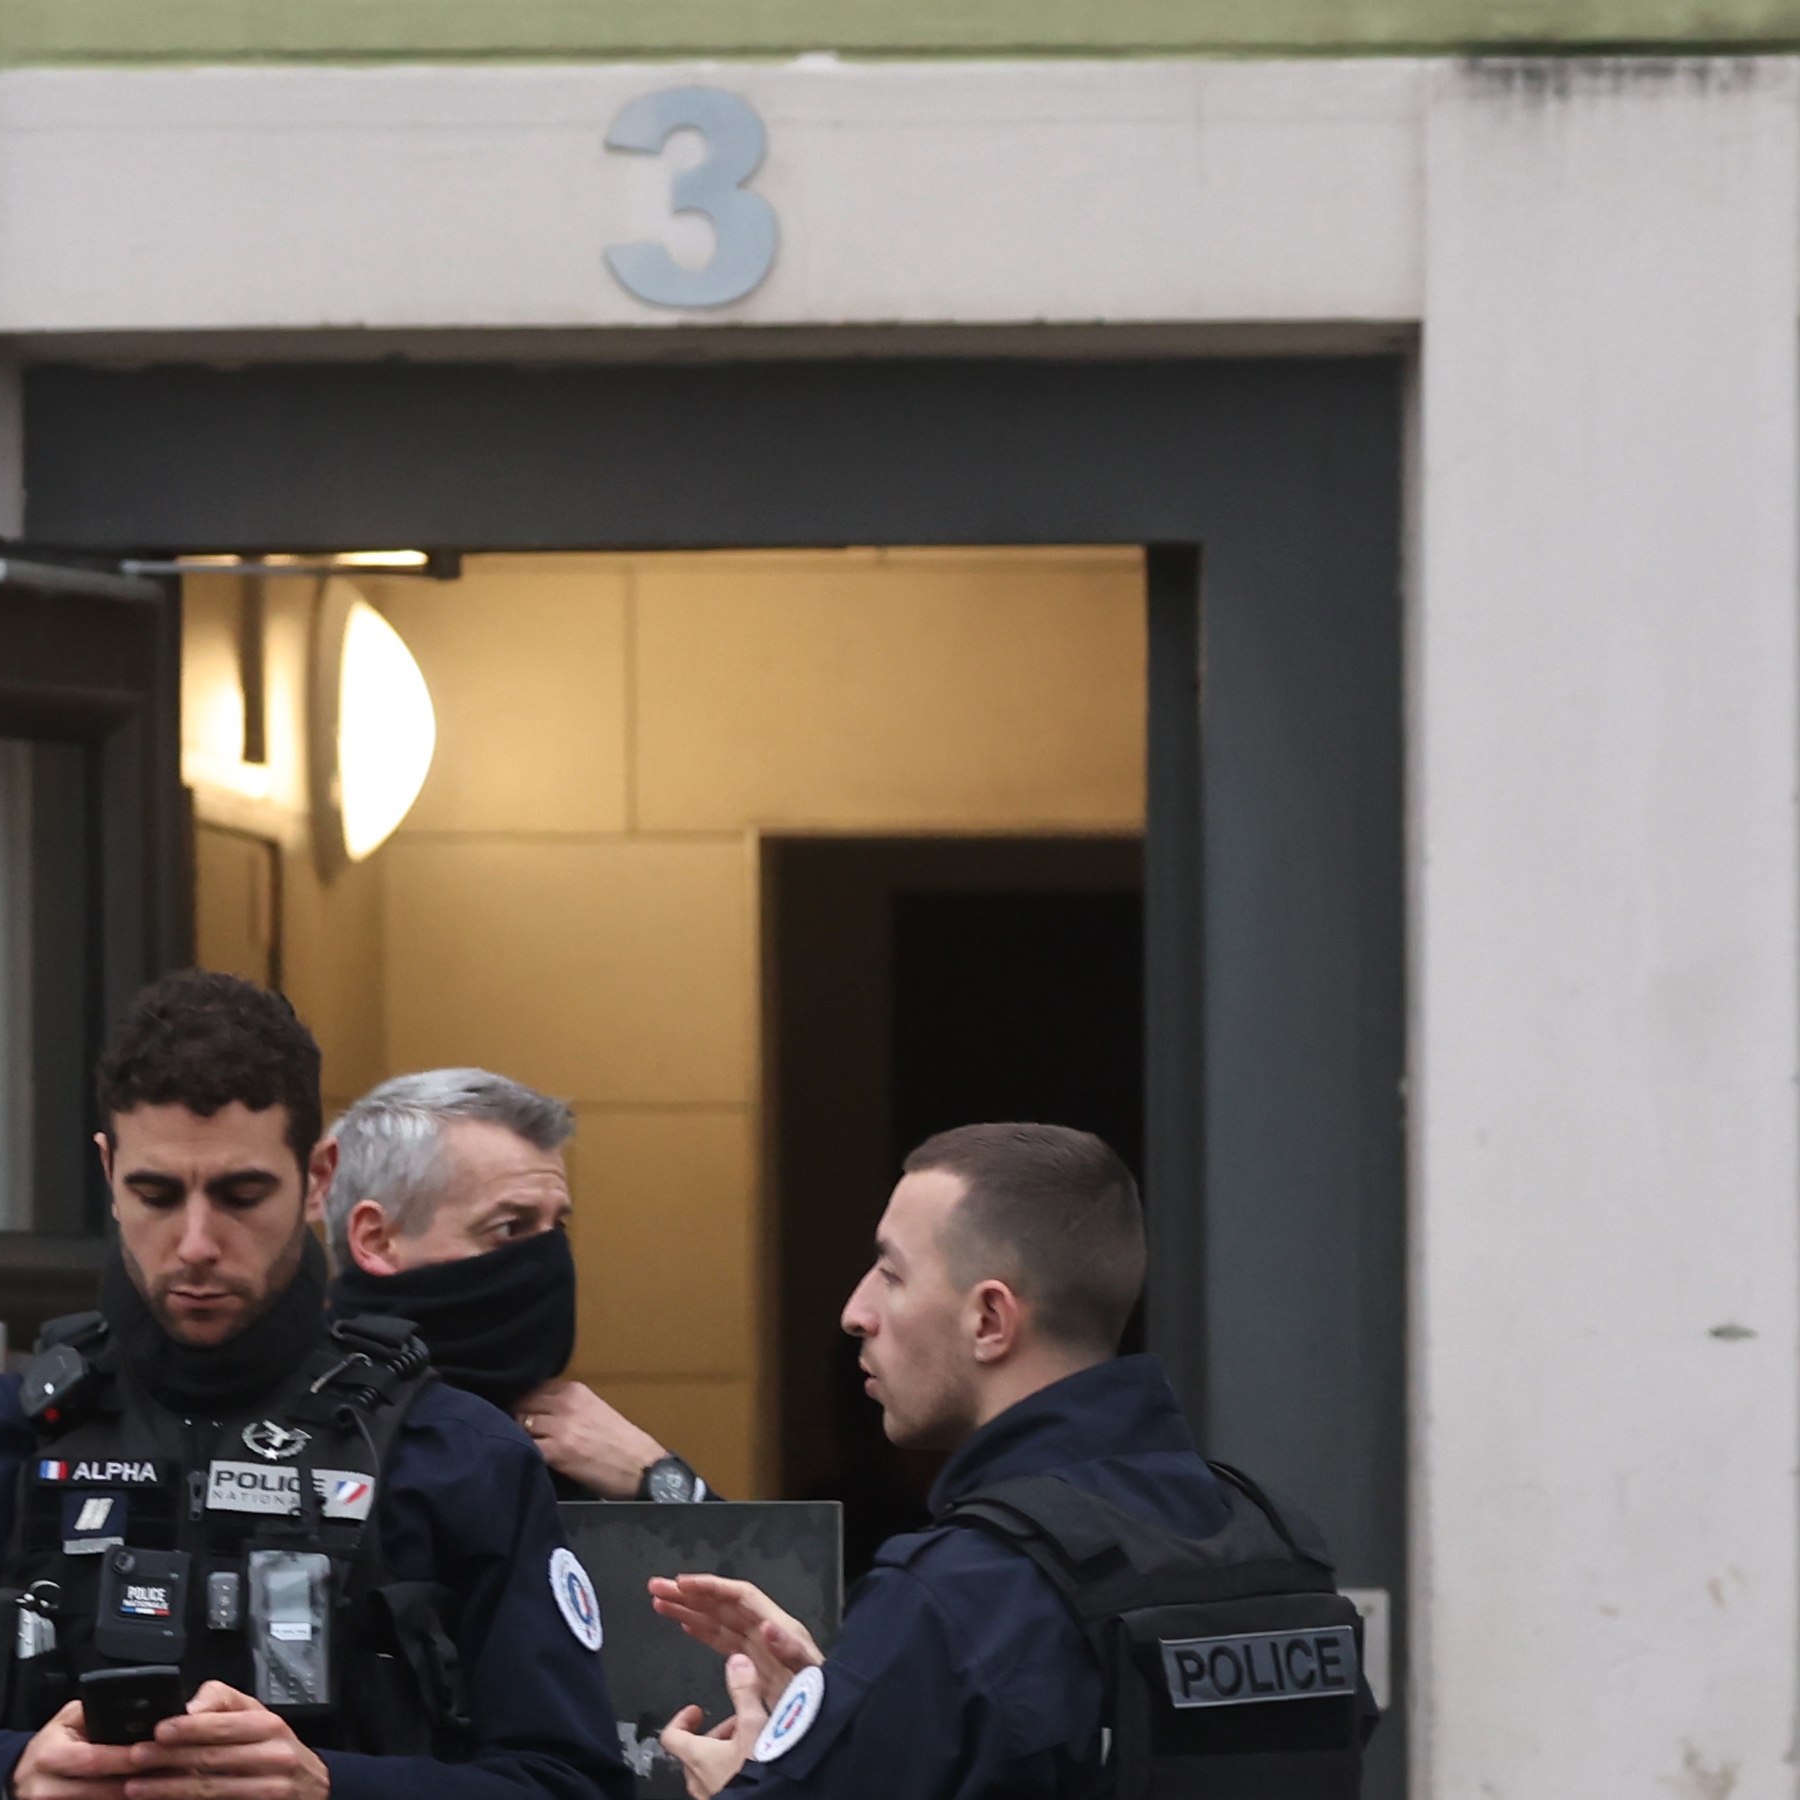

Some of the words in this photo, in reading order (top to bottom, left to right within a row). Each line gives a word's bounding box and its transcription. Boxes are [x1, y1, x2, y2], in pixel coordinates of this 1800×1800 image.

[603, 86, 780, 311] 3
[72, 1461, 158, 1483] ALPHA
[127, 1585, 167, 1602] POLICE
[1175, 1637, 1346, 1699] POLICE
